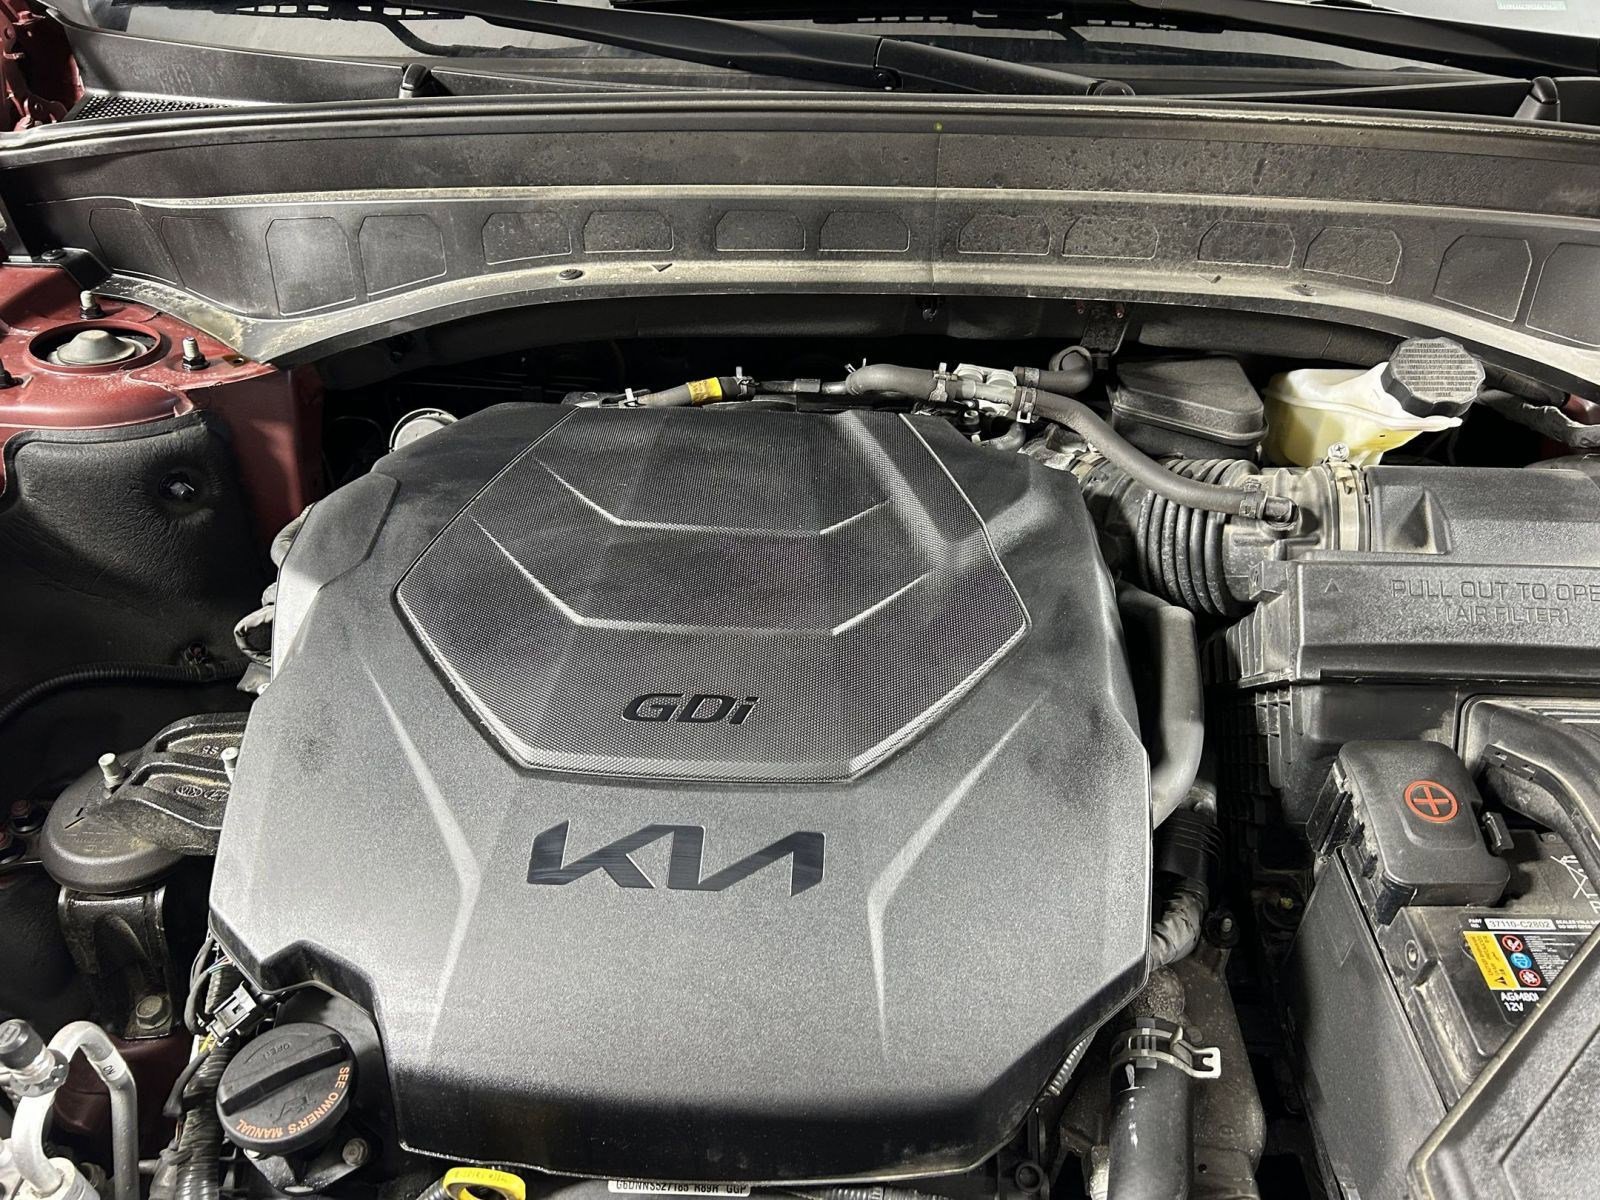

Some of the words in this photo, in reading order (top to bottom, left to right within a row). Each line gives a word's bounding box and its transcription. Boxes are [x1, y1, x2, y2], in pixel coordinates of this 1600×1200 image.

[1391, 579, 1453, 599] PULL
[1459, 580, 1509, 600] OUT
[1515, 582, 1548, 600] TO
[622, 692, 760, 725] GDi
[526, 819, 827, 897] KIA
[1489, 919, 1552, 929] 37110-C2802
[1503, 1002, 1524, 1012] 12V
[335, 1066, 350, 1089] SEE
[288, 1092, 339, 1134] OWNER'S
[236, 1118, 284, 1139] MANUAL
